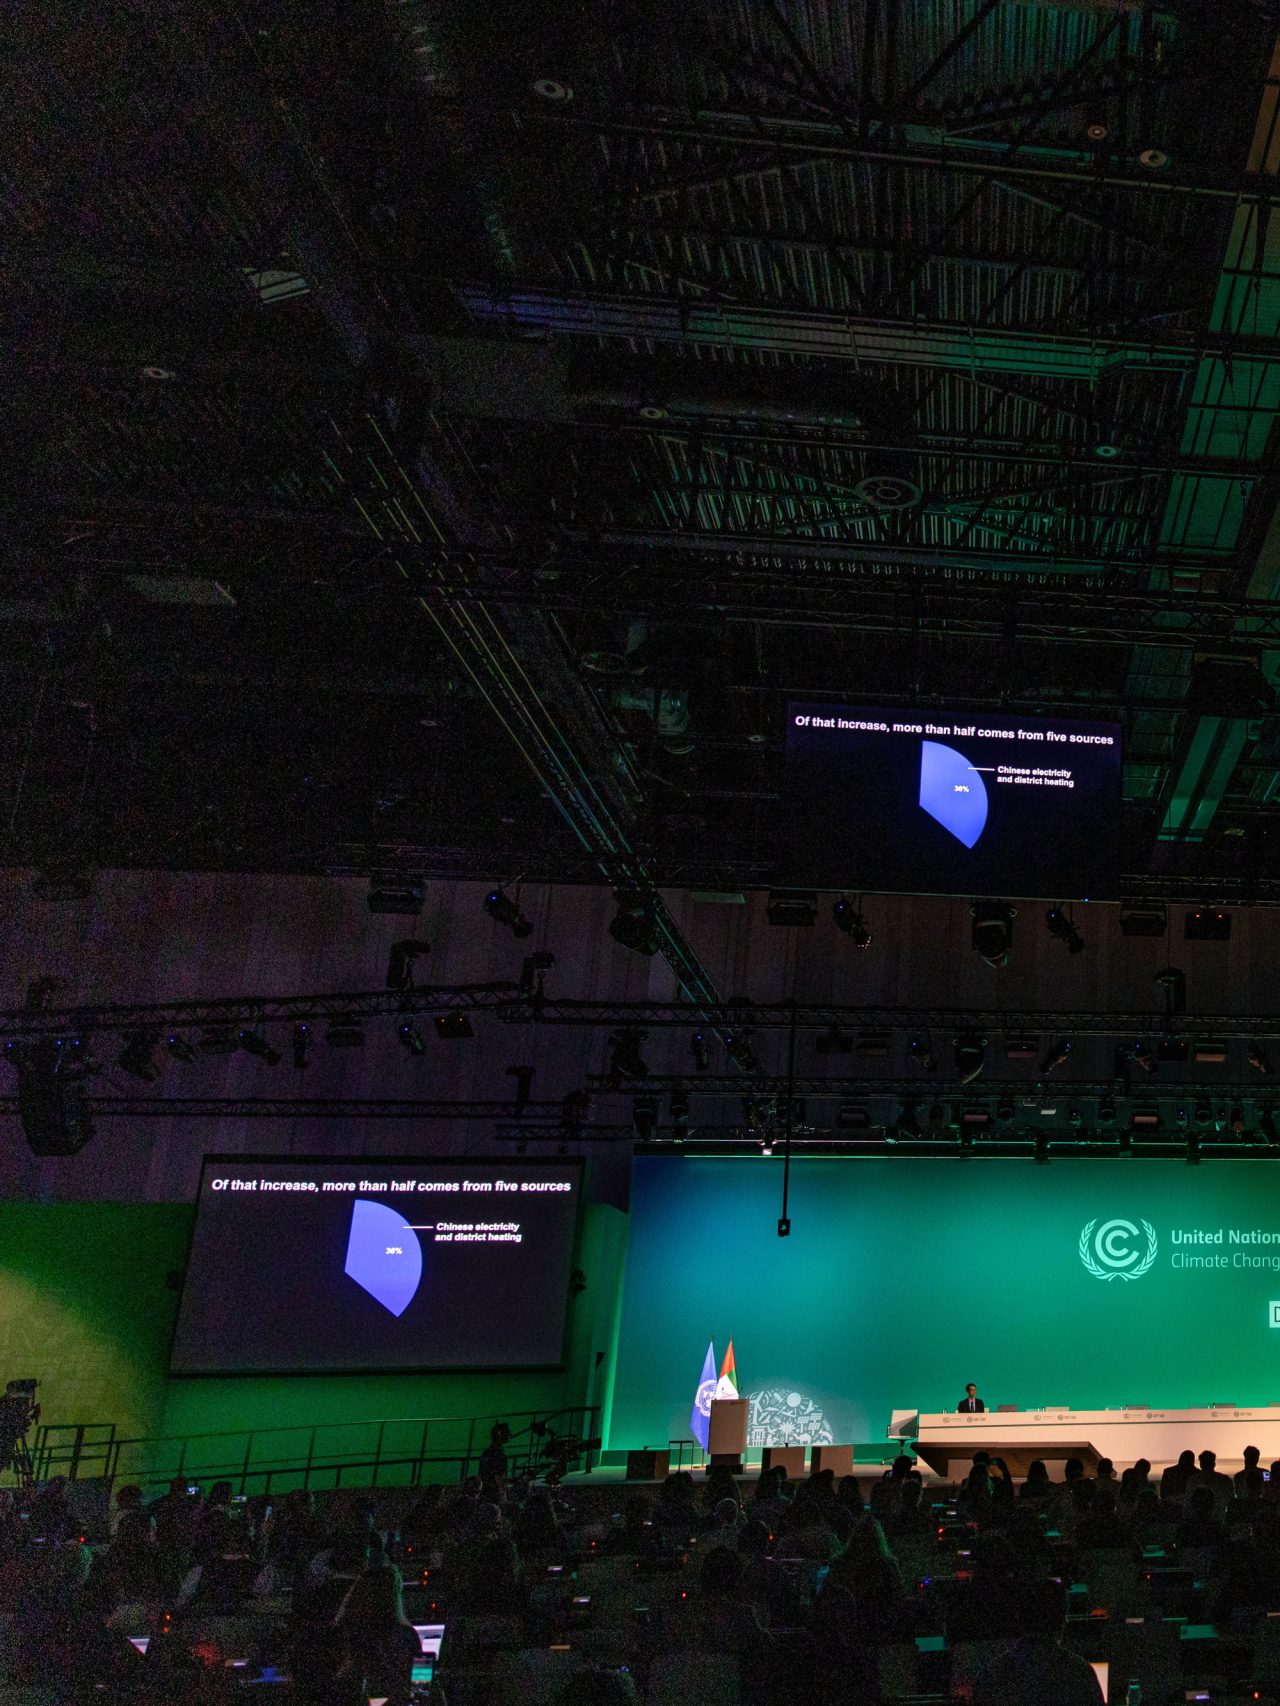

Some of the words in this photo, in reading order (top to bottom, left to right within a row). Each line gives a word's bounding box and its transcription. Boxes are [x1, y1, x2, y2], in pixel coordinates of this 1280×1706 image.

[794, 715, 811, 727] Of
[811, 716, 836, 728] that
[837, 717, 891, 733] increase,
[892, 723, 923, 734] more
[924, 723, 951, 735] than
[953, 725, 977, 737] half
[977, 728, 1016, 739] comes
[1017, 729, 1044, 741] from
[1046, 730, 1068, 742] five
[1069, 734, 1114, 745] sources
[997, 766, 1031, 775] Chinese
[1031, 768, 1072, 778] electricity
[996, 776, 1013, 784] and
[1013, 776, 1044, 785] district
[1043, 777, 1075, 788] heating
[211, 1178, 230, 1191] Of
[231, 1179, 258, 1191] that
[259, 1179, 319, 1193] increase,
[322, 1182, 357, 1192] more
[358, 1179, 388, 1192] than
[390, 1180, 416, 1192] half
[417, 1182, 460, 1192] comes
[462, 1180, 493, 1192] from
[494, 1180, 519, 1192] five
[520, 1182, 572, 1192] sources
[436, 1223, 474, 1231] Chinese
[474, 1223, 521, 1234] electricity
[434, 1233, 453, 1242] and
[453, 1233, 487, 1242] district
[487, 1233, 523, 1243] heating
[1172, 1229, 1222, 1244] United
[1172, 1253, 1228, 1267] Climate
